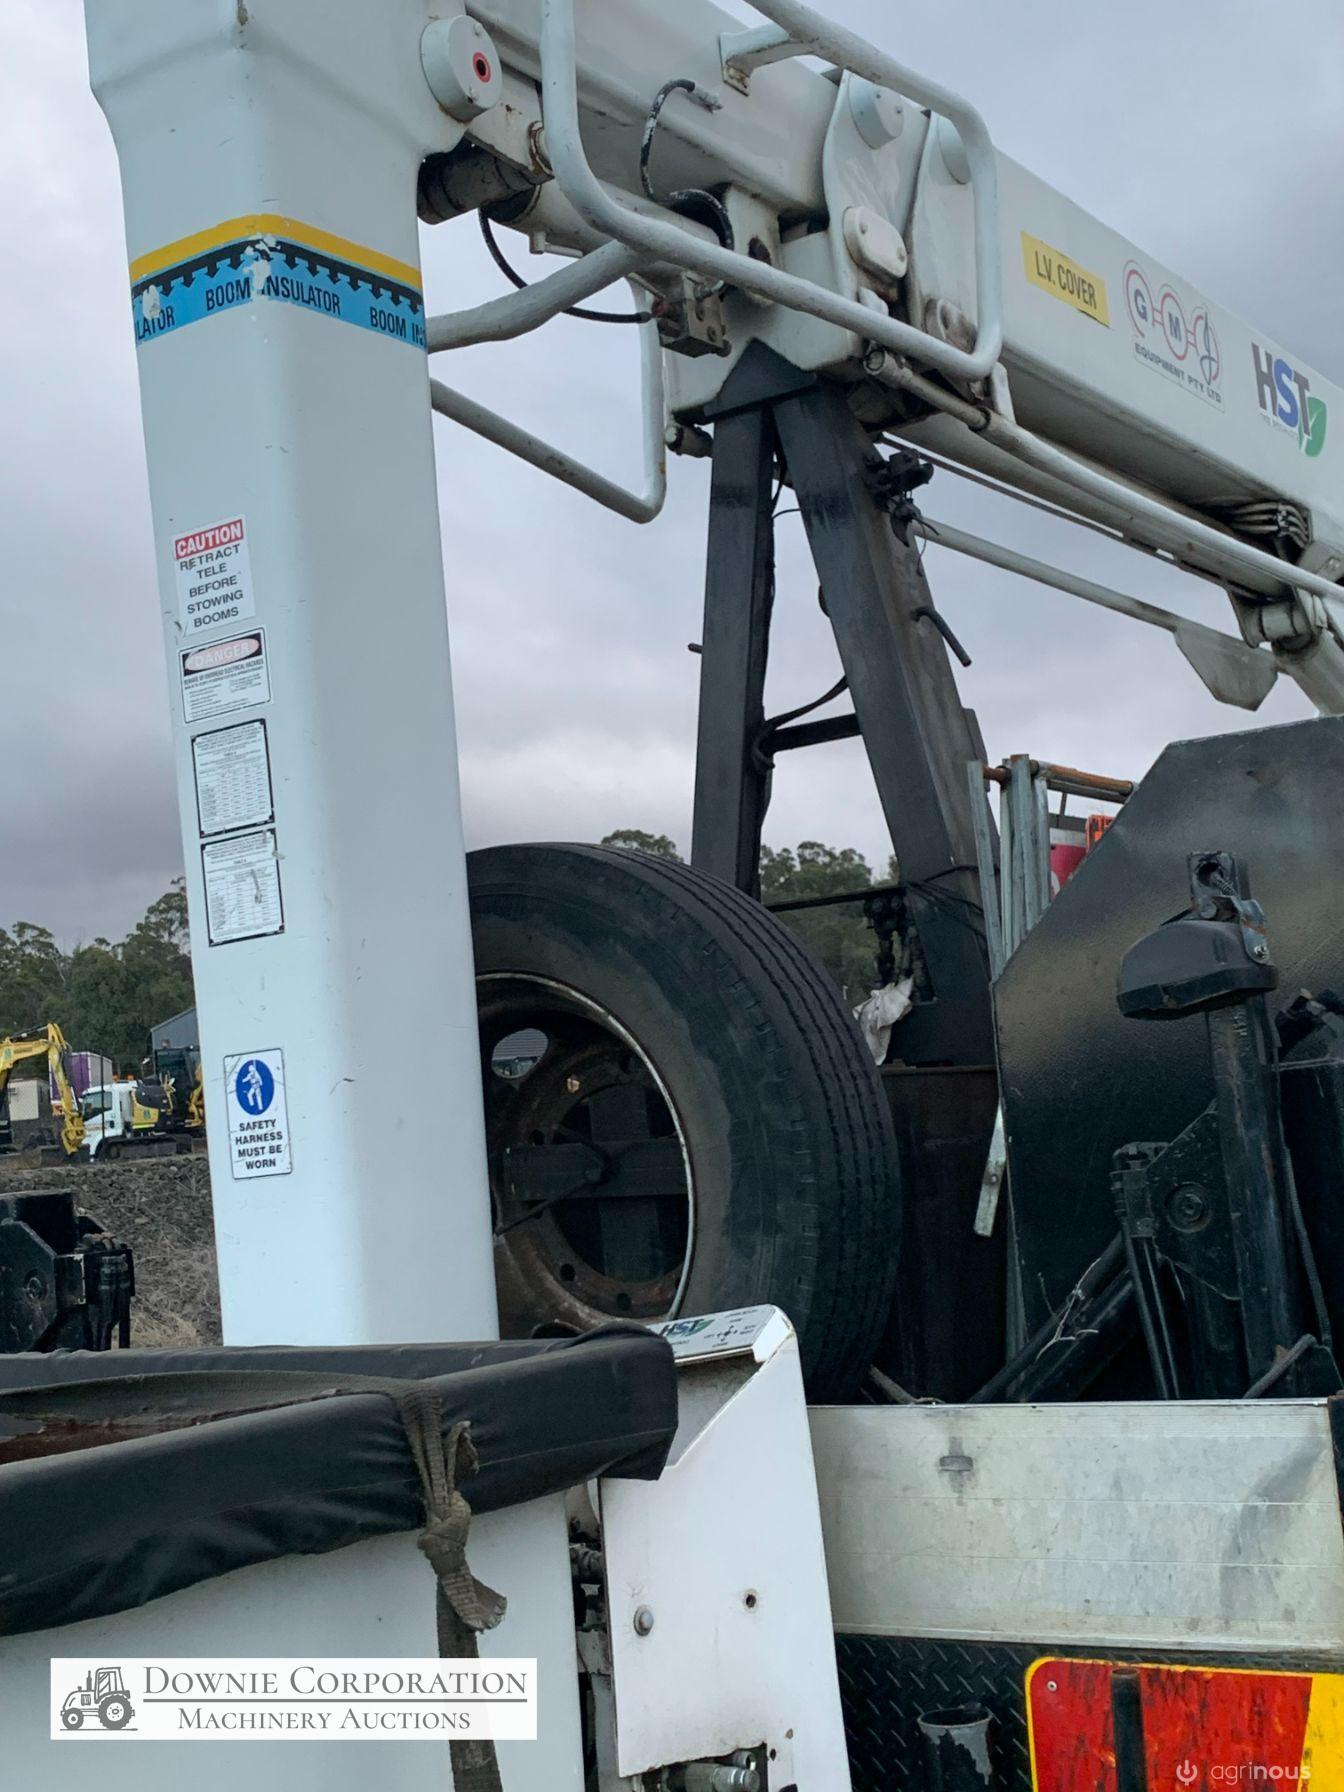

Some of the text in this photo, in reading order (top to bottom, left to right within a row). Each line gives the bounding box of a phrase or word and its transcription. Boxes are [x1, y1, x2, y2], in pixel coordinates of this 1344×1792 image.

[1057, 263, 1097, 309] COVER
[205, 276, 251, 312] BOOM
[370, 306, 407, 339] BOOM
[1135, 342, 1223, 404] EQUIPMENT PTY LTD
[1251, 342, 1311, 437] HST
[176, 522, 243, 557] CAUTION
[180, 543, 241, 571] RETRACT
[196, 562, 228, 579] TELE
[189, 575, 238, 598] BEFORE
[187, 590, 244, 615] STOWING
[194, 606, 240, 628] BOOMS
[239, 1119, 277, 1132] SAFETY
[235, 1131, 283, 1146] HARNESS
[238, 1144, 283, 1158] MUST BE
[245, 1158, 277, 1170] WORN
